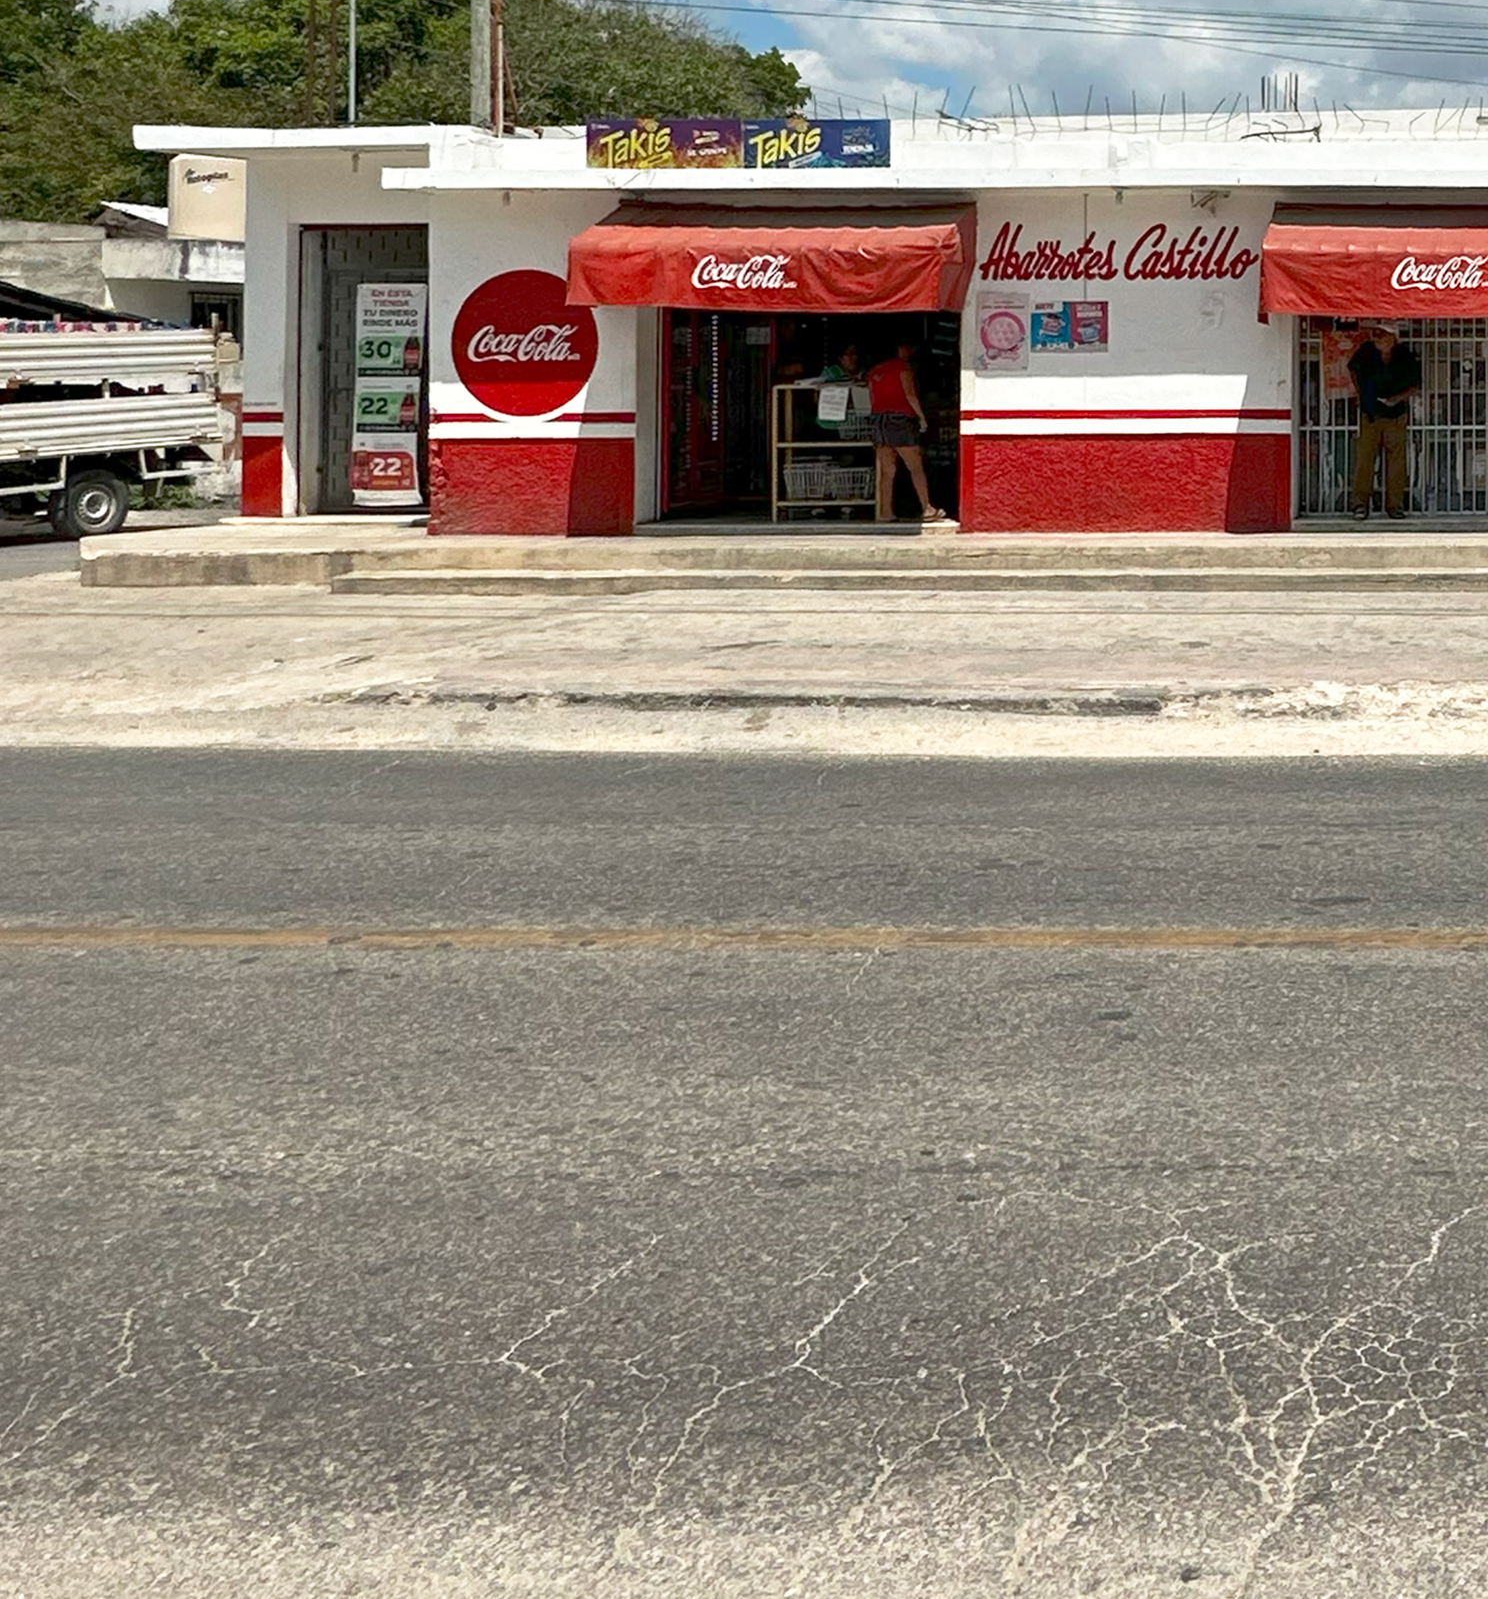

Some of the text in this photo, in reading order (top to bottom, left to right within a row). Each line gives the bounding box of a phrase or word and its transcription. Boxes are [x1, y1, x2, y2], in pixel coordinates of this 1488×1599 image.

[600, 127, 671, 168] Takis
[749, 127, 821, 168] Takis
[979, 221, 1260, 281] Abarrotes Castillo
[691, 254, 793, 290] Coca-Cola
[467, 324, 579, 363] Coca-Cola
